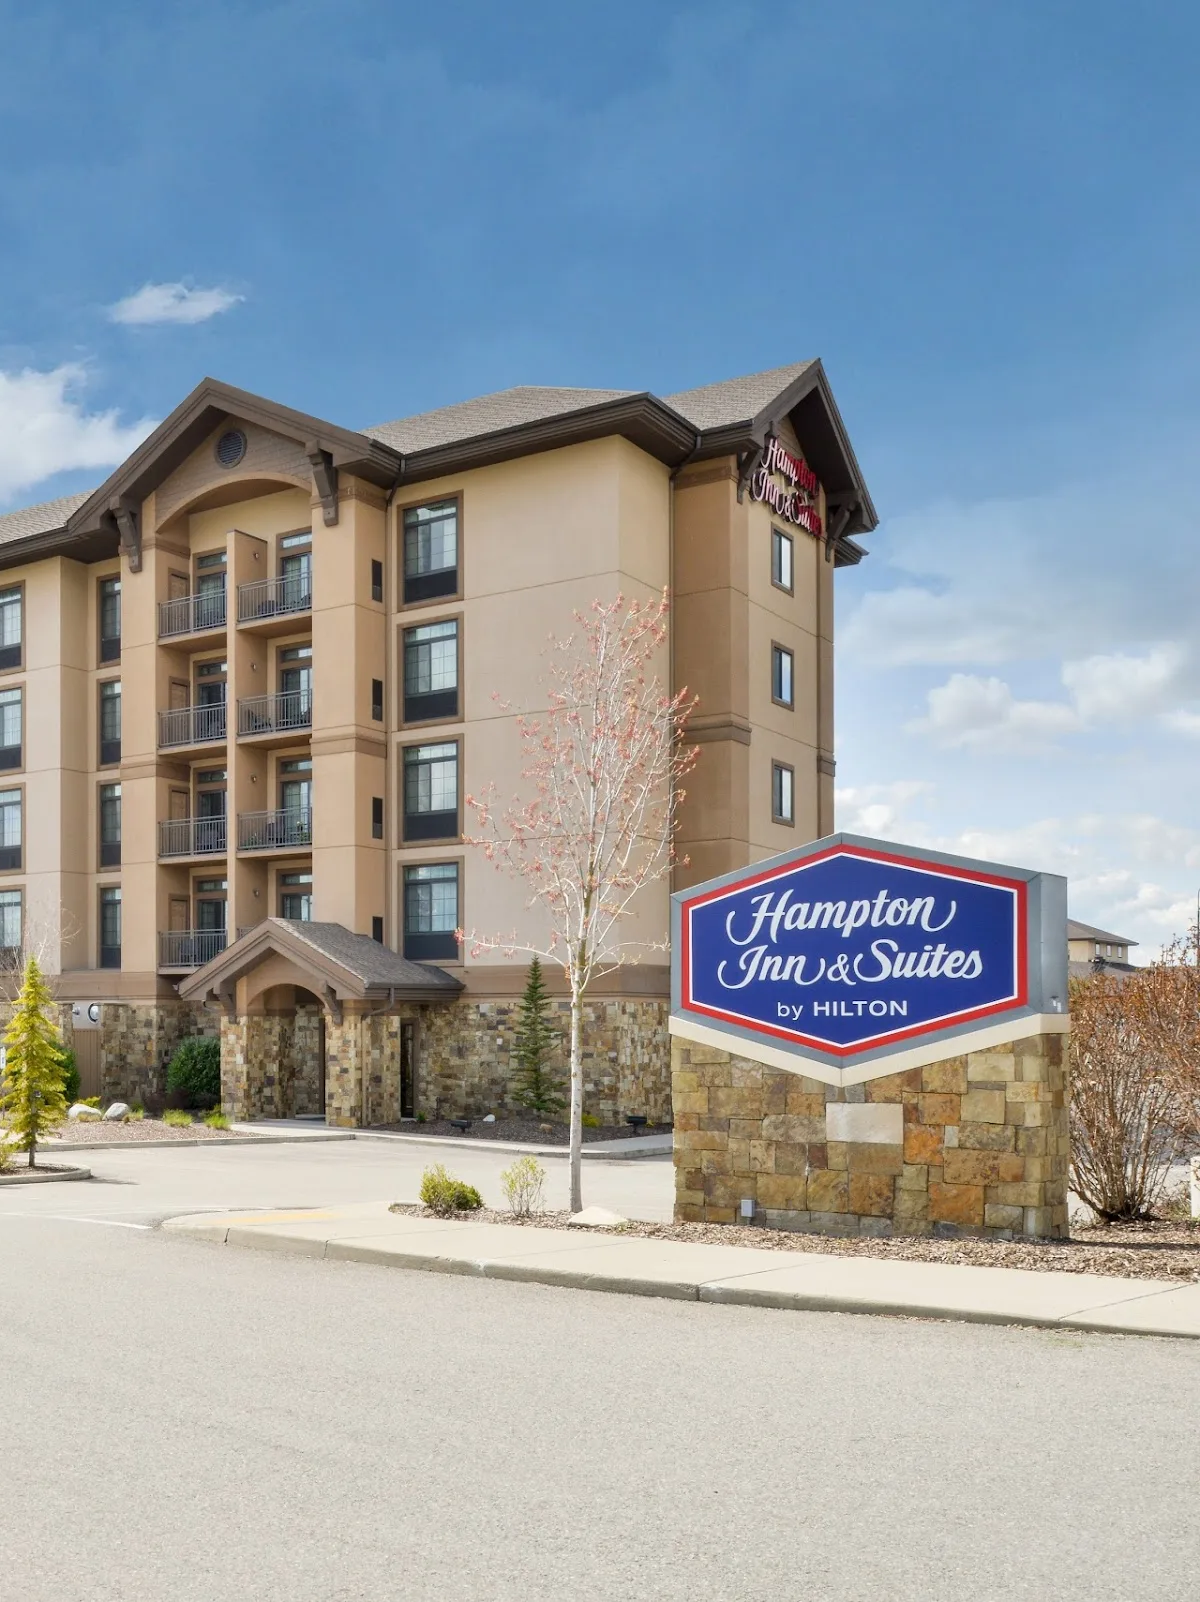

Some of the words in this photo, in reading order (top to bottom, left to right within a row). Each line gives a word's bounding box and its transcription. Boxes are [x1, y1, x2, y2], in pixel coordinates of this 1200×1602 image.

[752, 468, 785, 515] Inn
[760, 438, 819, 498] Hampton
[725, 889, 957, 947] Hampton
[717, 945, 825, 989] Inn
[827, 953, 857, 986] &
[853, 938, 983, 982] Suites
[777, 1001, 803, 1021] by
[813, 1000, 908, 1017] HILTON
